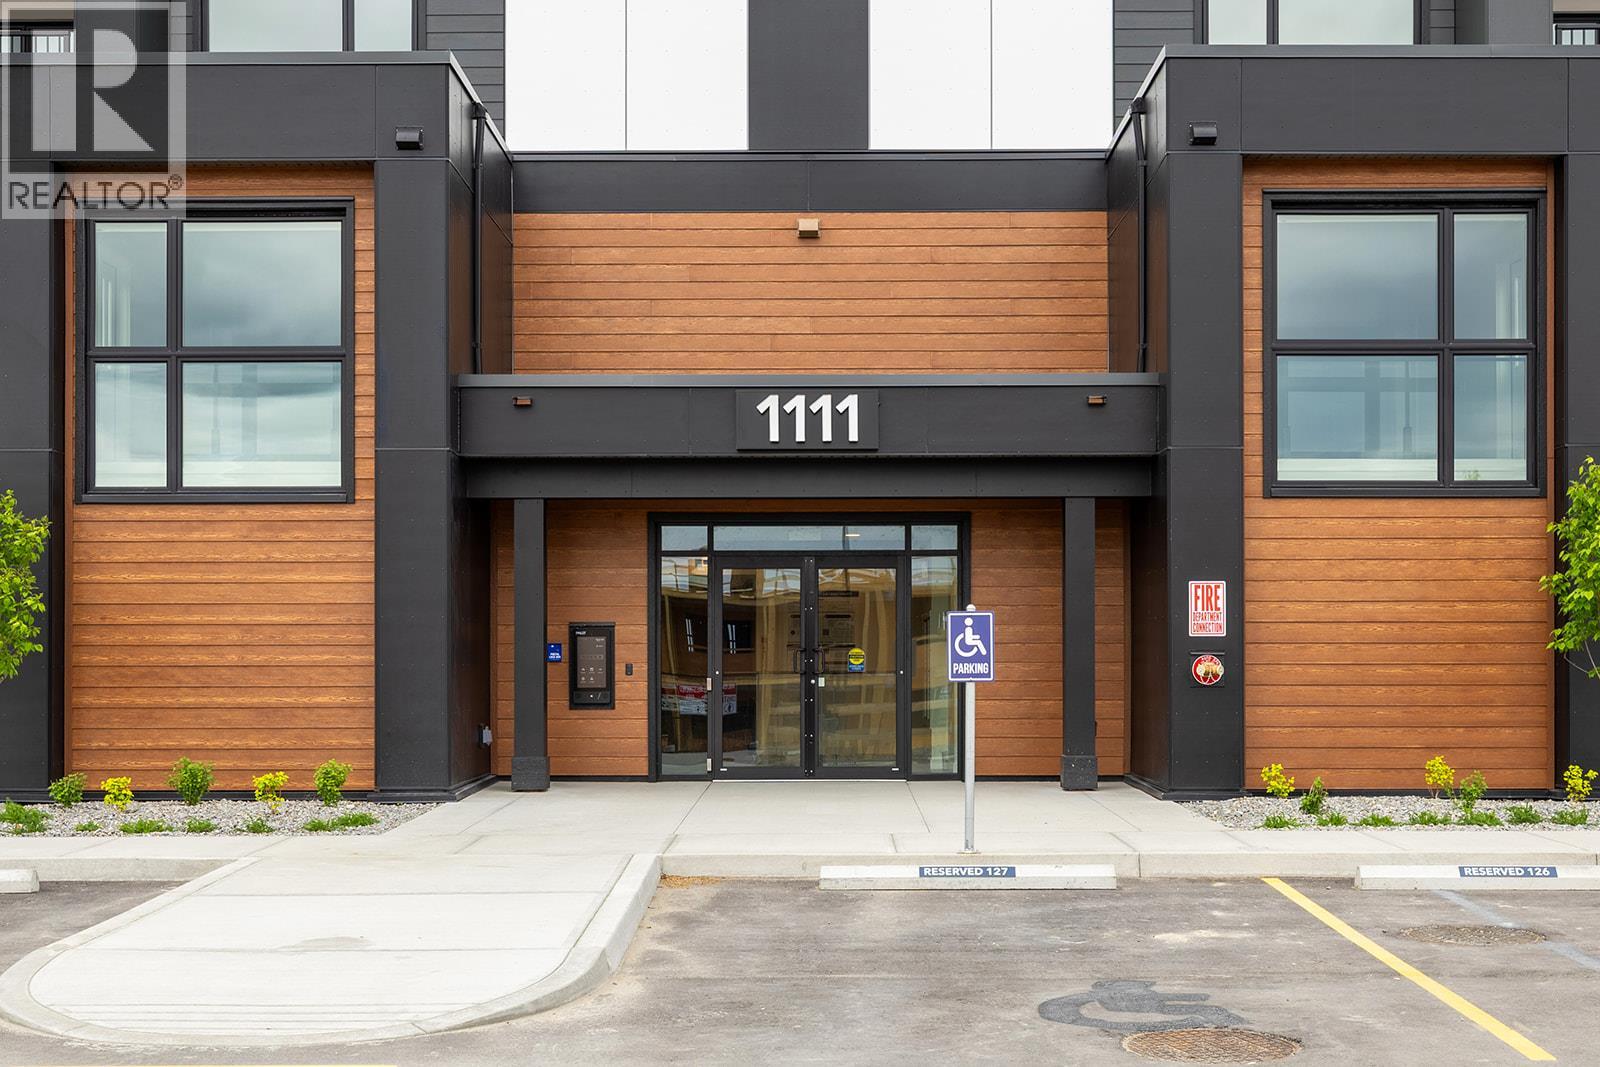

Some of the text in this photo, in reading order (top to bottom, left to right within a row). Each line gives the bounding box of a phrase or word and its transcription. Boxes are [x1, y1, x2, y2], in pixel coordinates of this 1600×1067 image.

[756, 394, 859, 442] 1111
[1194, 584, 1221, 612] FIRE
[1193, 611, 1222, 622] DEPARTMENT
[1193, 622, 1223, 633] CONNECTION
[953, 662, 989, 674] PARKING
[923, 867, 1008, 876] RESERVED 127
[1463, 867, 1550, 876] RESERVED 126
